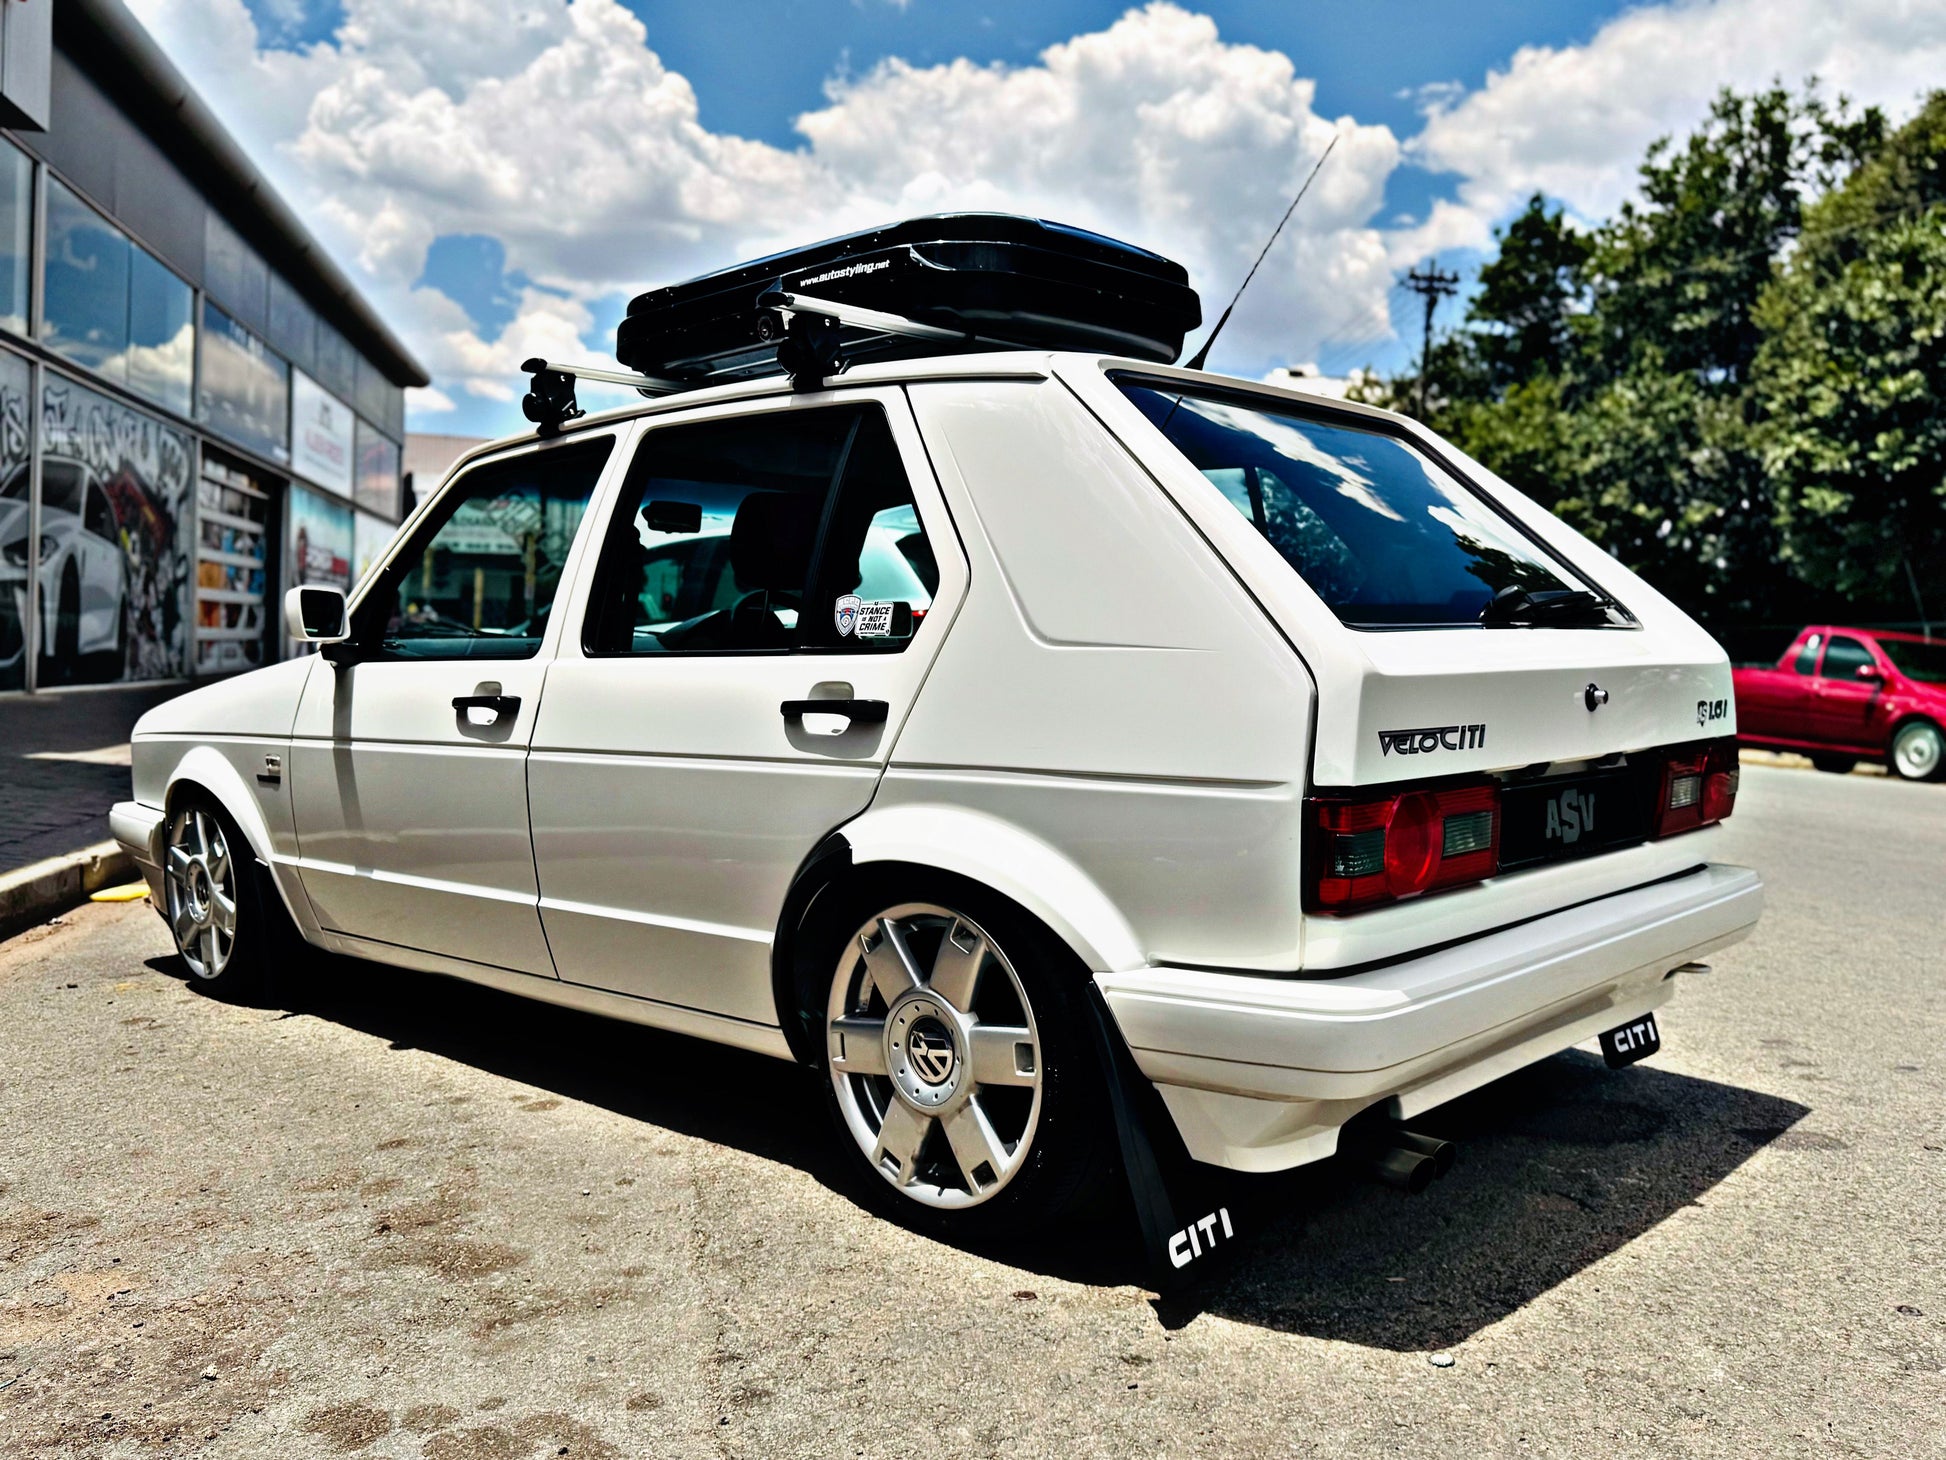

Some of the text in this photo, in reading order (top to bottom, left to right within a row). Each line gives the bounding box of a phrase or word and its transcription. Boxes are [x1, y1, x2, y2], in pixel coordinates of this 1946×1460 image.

[799, 259, 890, 287] www.autostyling.net
[859, 607, 891, 615] STANCE
[859, 623, 887, 631] CRIME
[1545, 788, 1596, 844] ASV
[1613, 1021, 1656, 1053] CITI
[1168, 1207, 1234, 1269] CITI
